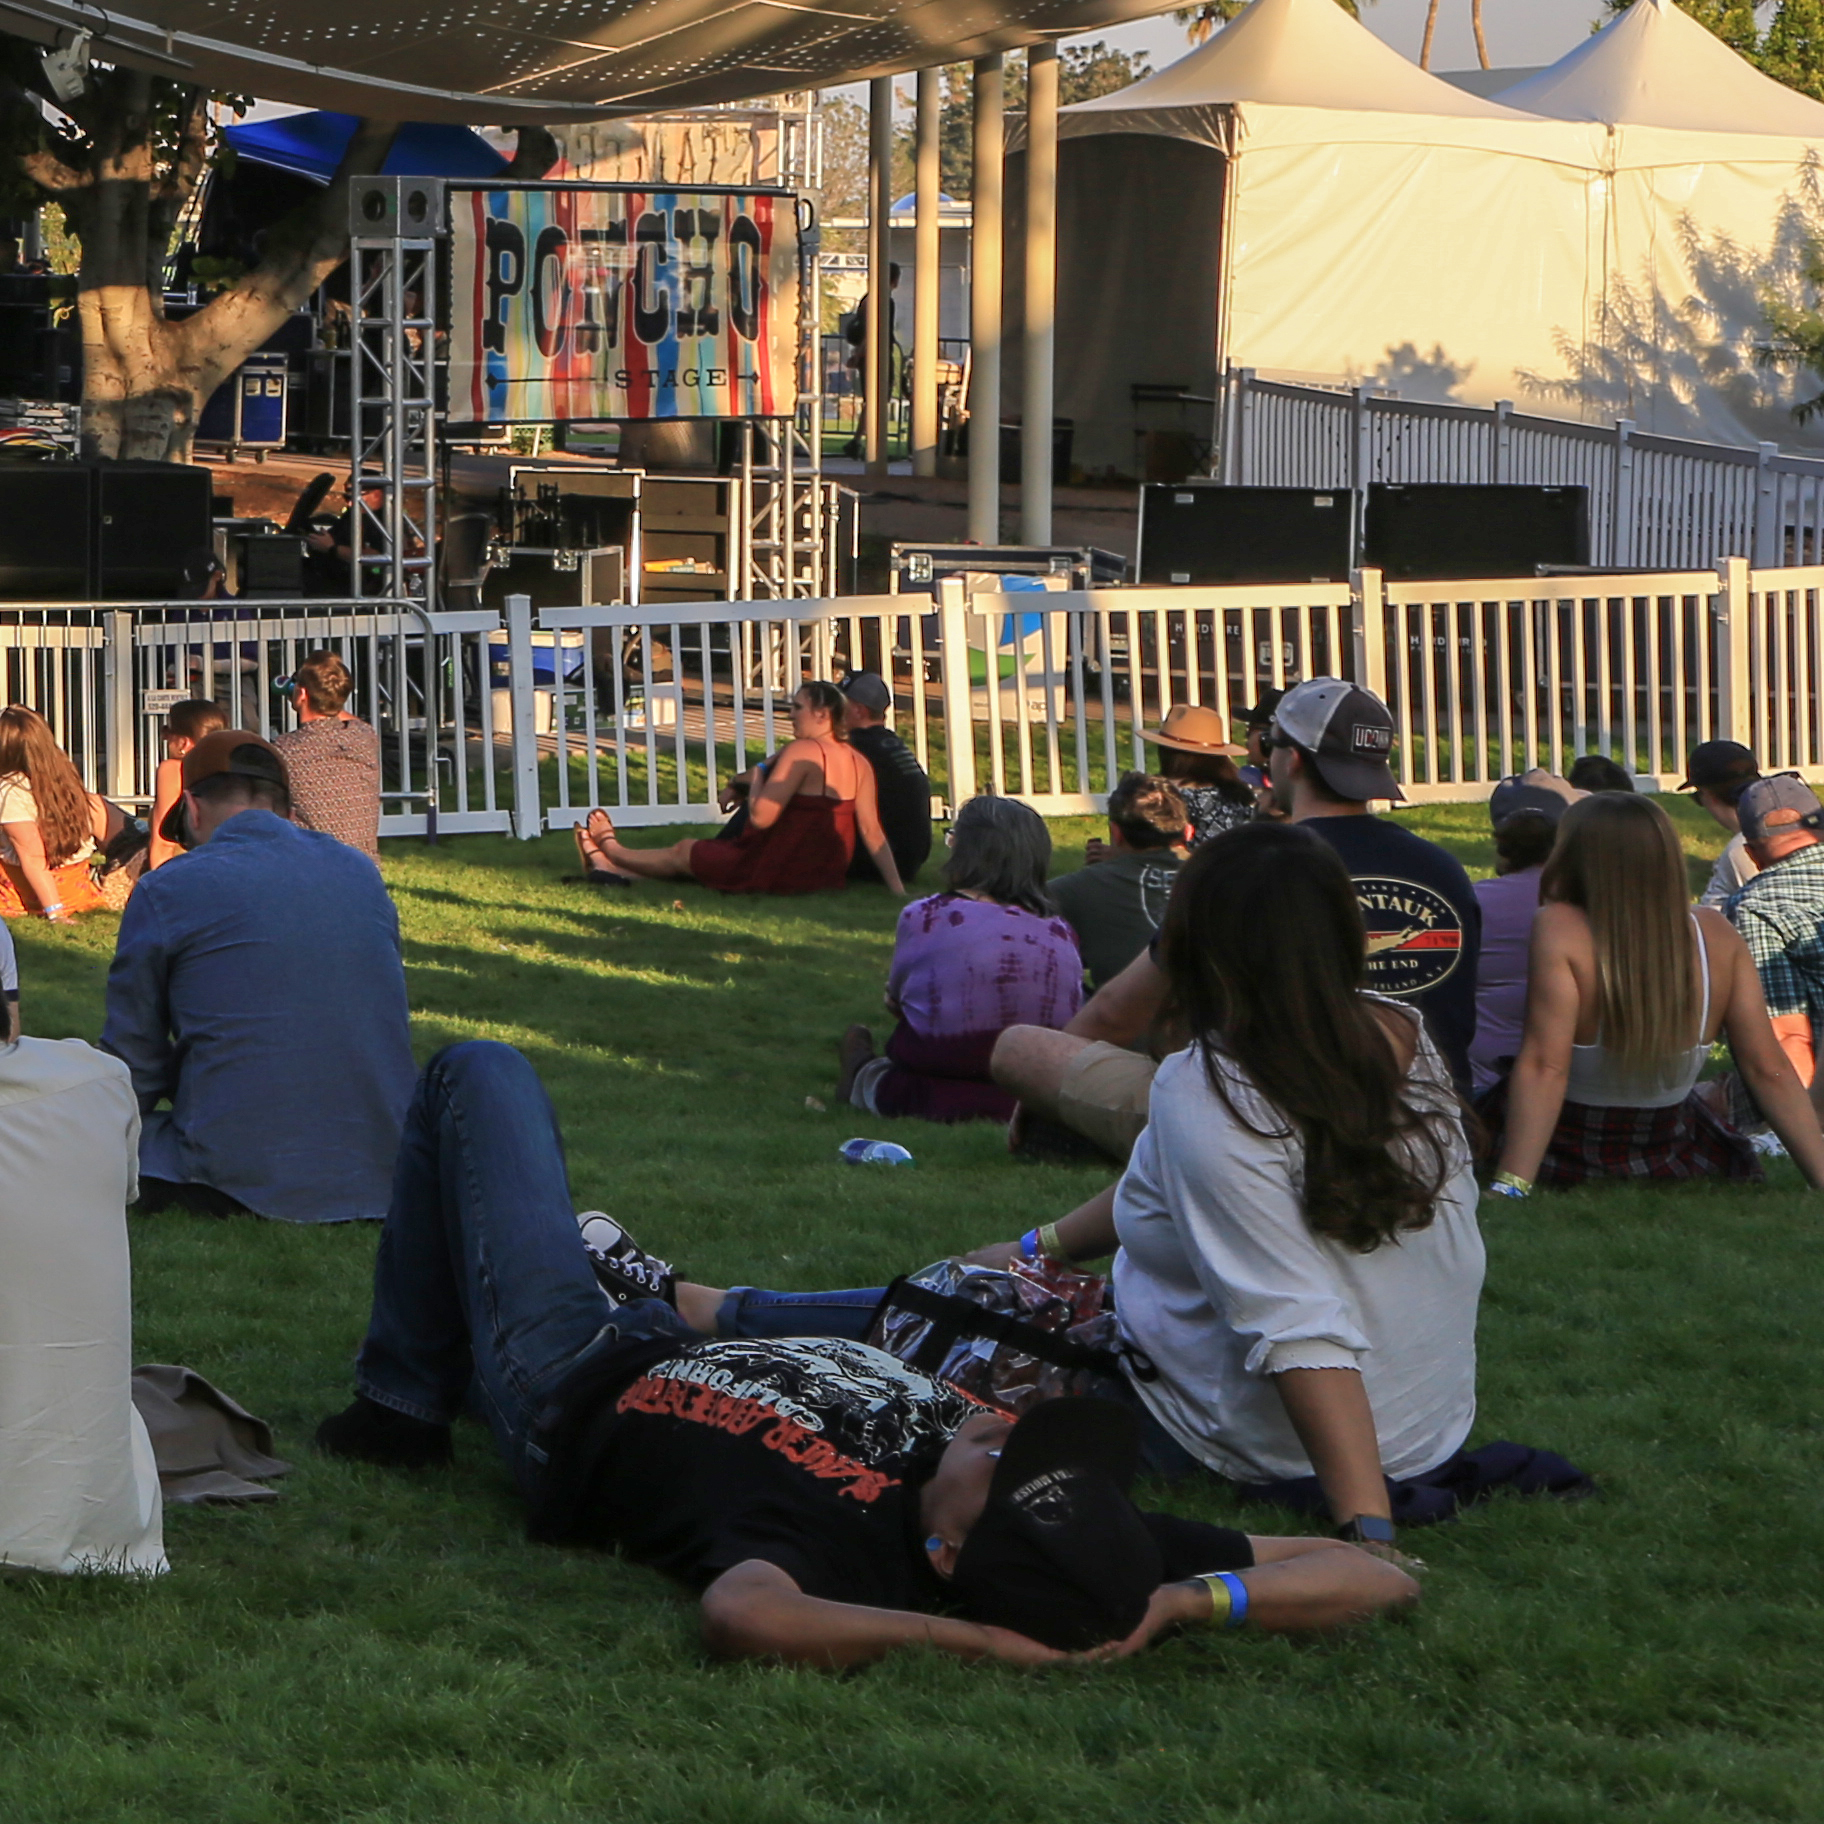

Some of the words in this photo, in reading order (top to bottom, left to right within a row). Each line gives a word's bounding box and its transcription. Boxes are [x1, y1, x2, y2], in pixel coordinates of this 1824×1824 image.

[482, 207, 762, 359] PONCHO
[614, 367, 730, 389] STAGE
[1356, 893, 1438, 929] NTAUK
[1368, 961, 1387, 971] HE
[1391, 959, 1419, 970] END
